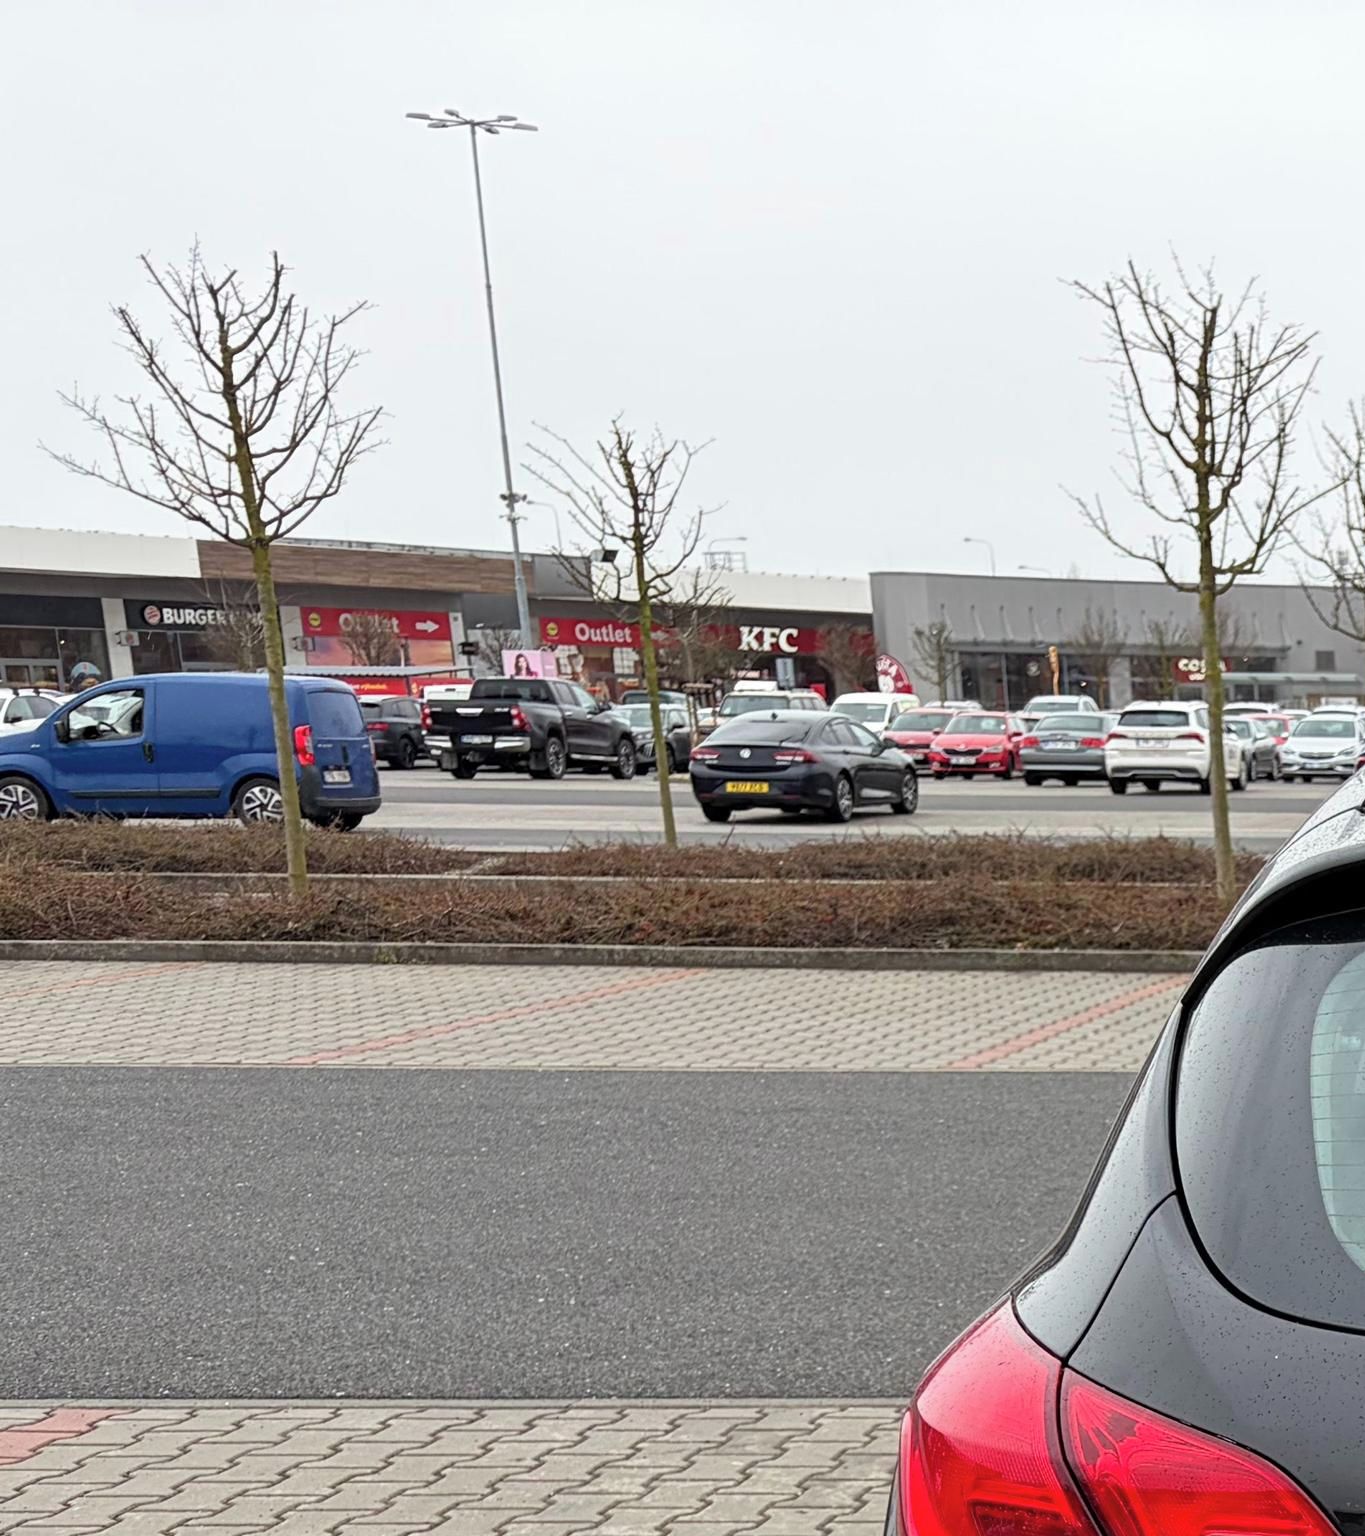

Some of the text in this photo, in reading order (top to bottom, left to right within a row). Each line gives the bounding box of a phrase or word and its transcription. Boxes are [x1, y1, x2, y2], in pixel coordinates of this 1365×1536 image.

[162, 607, 227, 626] BURGER
[574, 622, 633, 643] Outlet
[737, 625, 799, 653] KFC
